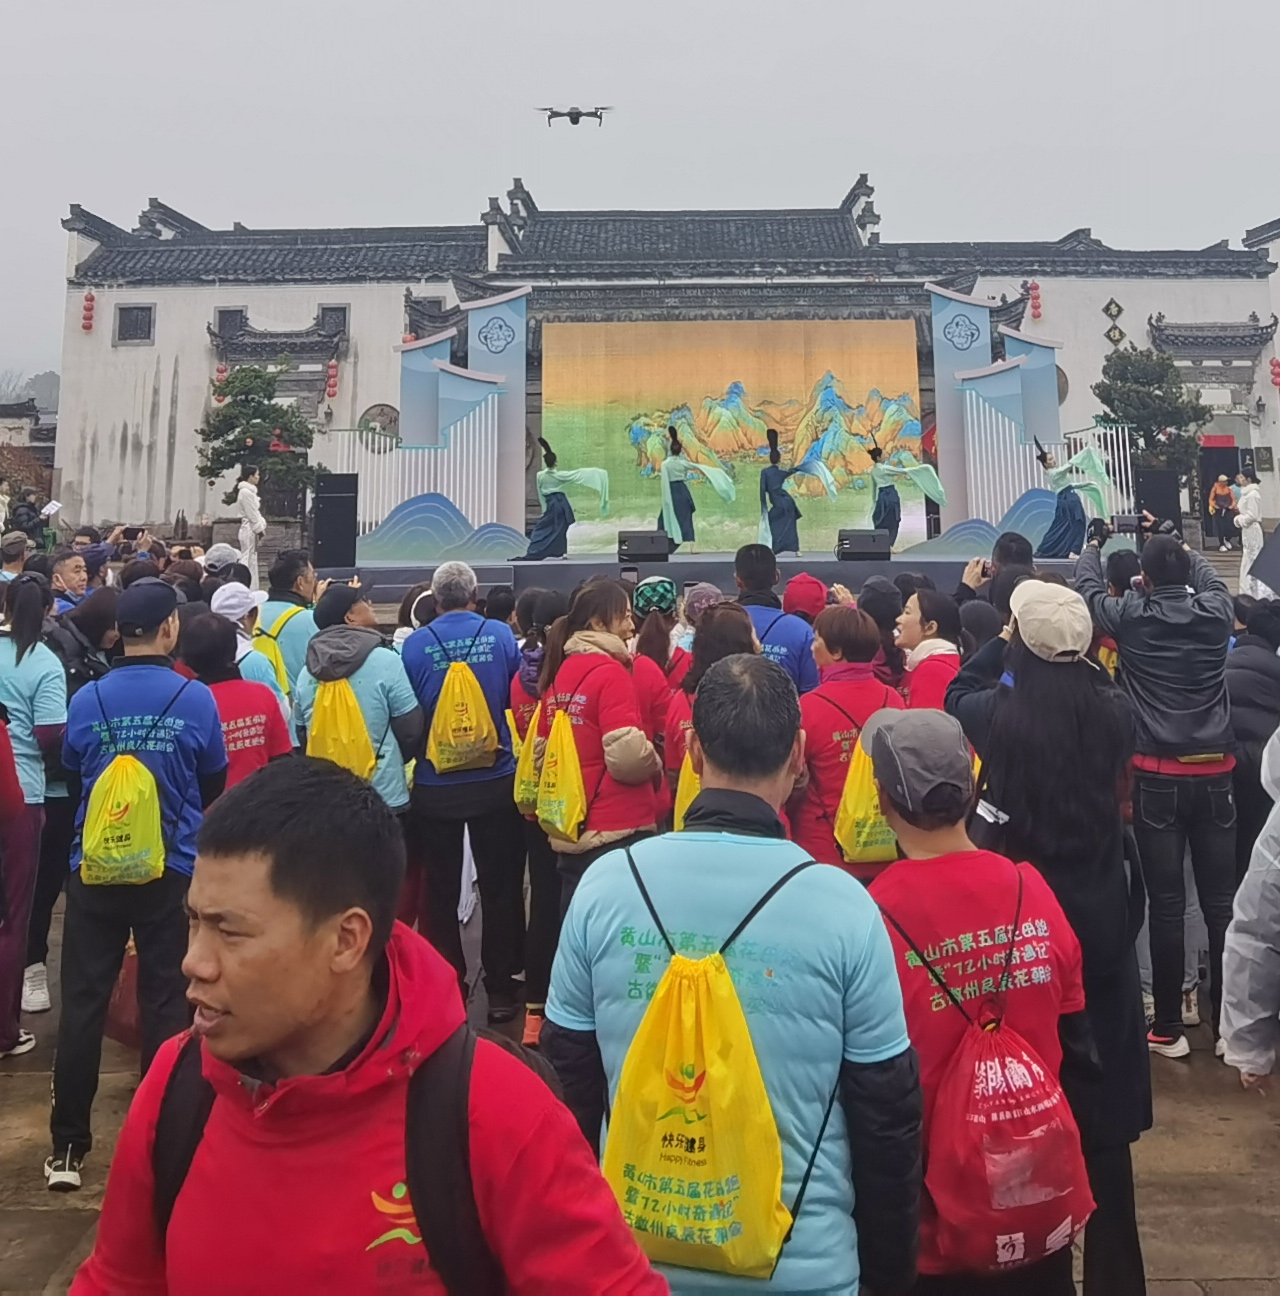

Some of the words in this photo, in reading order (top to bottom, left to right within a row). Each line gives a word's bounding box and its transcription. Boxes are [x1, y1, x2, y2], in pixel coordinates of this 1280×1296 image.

[904, 917, 1050, 970] 黄山市第五届花田跑
[661, 1132, 707, 1154] 快乐健身
[659, 1152, 683, 1166] Happy
[683, 1156, 708, 1167] Fitness
